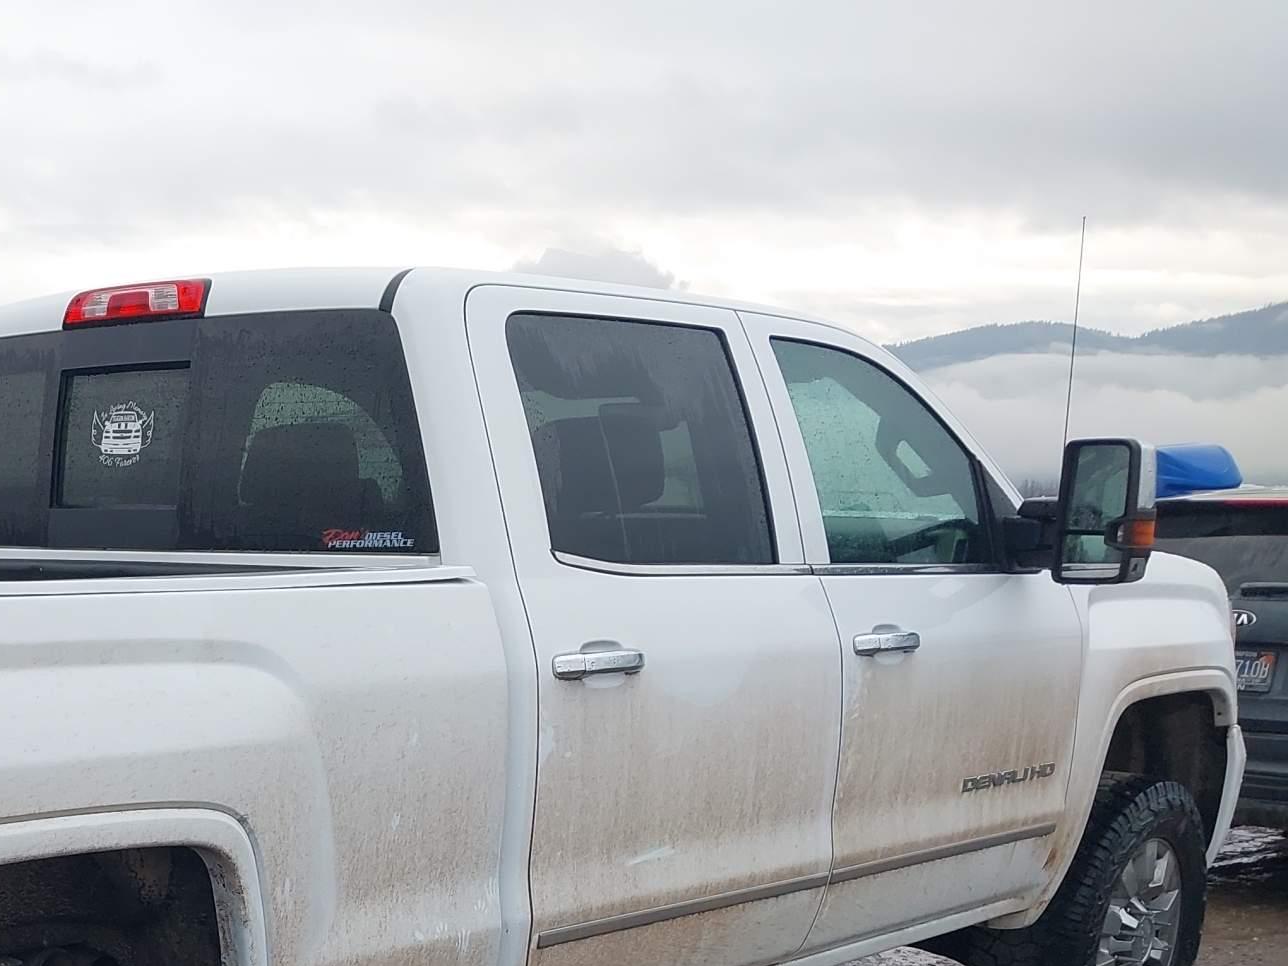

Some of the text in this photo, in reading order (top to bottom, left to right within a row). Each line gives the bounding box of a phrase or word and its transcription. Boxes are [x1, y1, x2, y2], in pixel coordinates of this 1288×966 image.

[365, 532, 402, 540] DIESEL
[327, 539, 414, 548] PERFORMANCE
[961, 761, 1056, 793] DENALI HD
